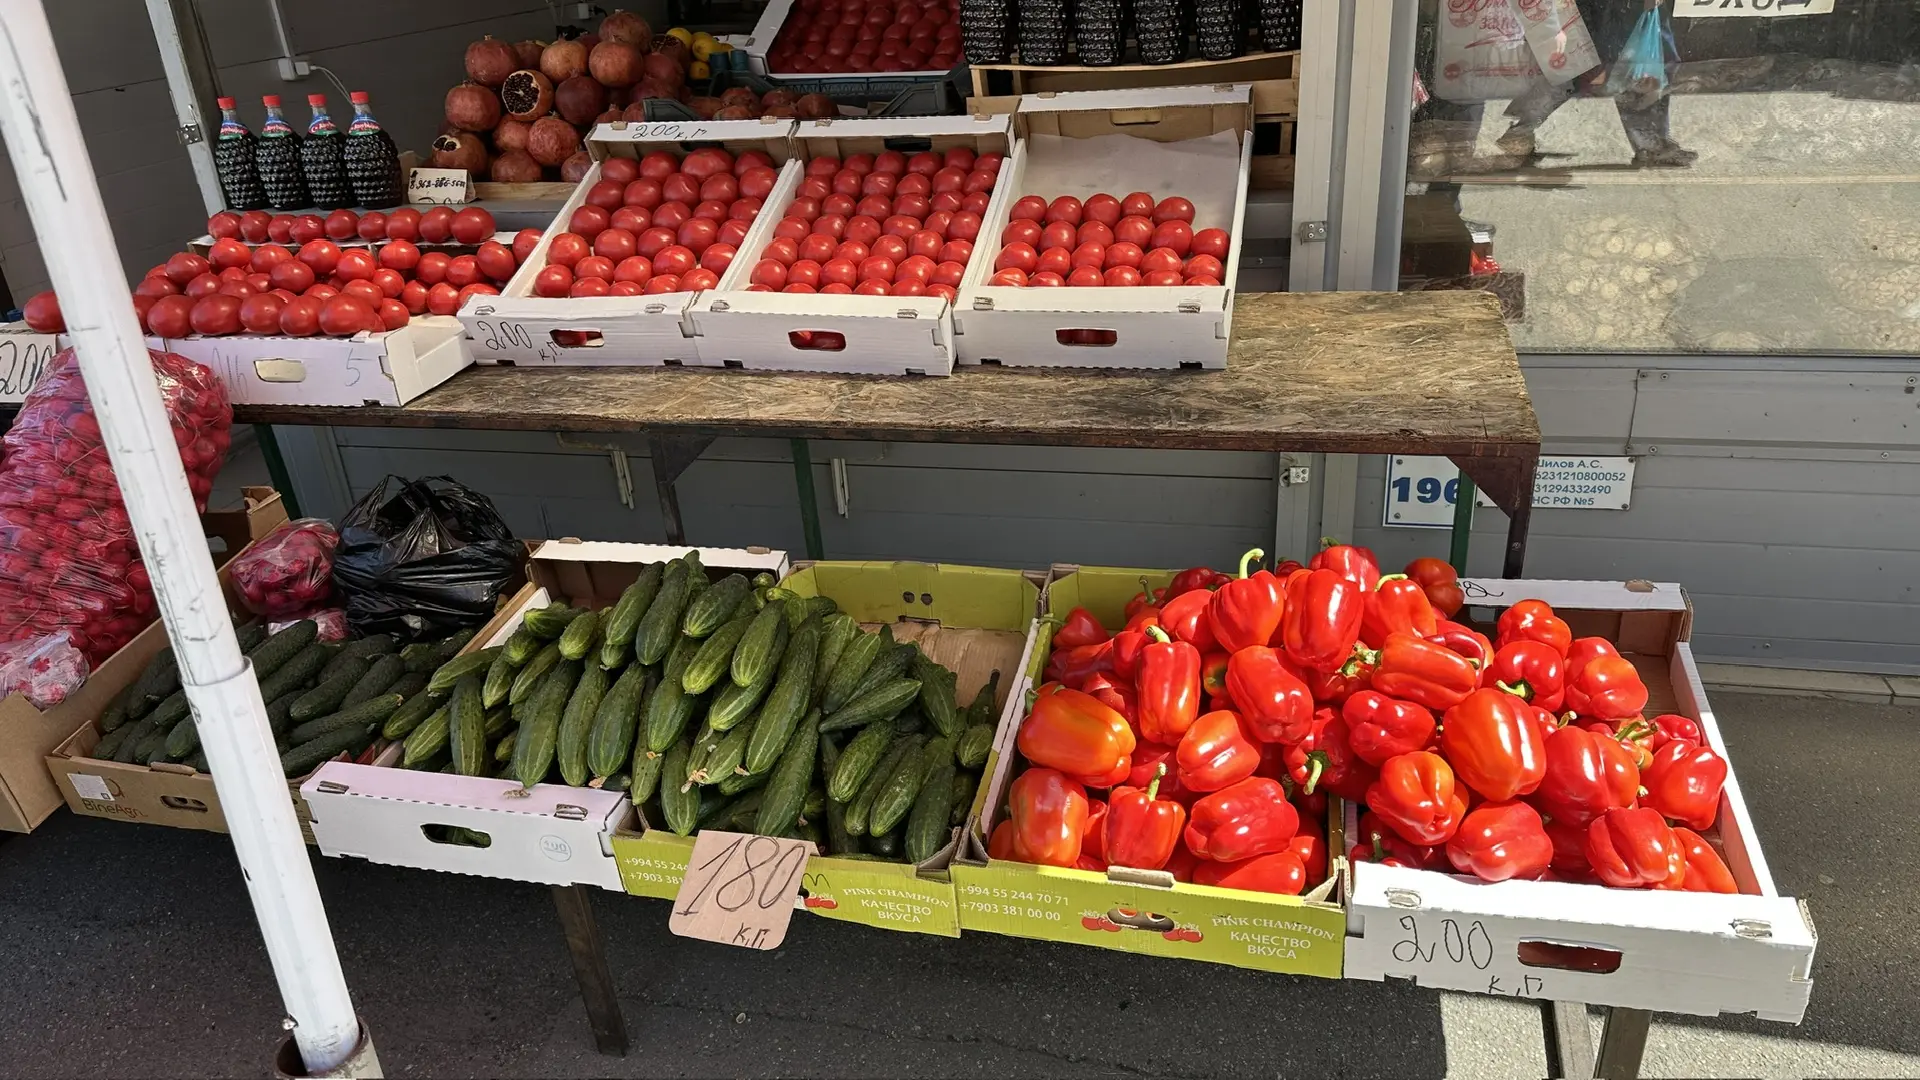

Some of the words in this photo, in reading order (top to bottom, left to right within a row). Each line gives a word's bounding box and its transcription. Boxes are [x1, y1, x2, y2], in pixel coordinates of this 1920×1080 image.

[632, 124, 680, 139] 200
[477, 321, 532, 350] 200
[345, 347, 373, 387] 5
[1577, 460, 1603, 469] А.С.
[1553, 496, 1571, 505] РФ
[1574, 497, 1595, 506] №5
[624, 857, 652, 868] +994
[655, 859, 668, 869] 55
[630, 872, 663, 883] +7903
[675, 836, 806, 916] 180
[843, 887, 876, 896] PINK
[881, 888, 951, 908] CHAMPION
[958, 885, 990, 897] +994
[993, 888, 1008, 898] 55
[1011, 890, 1034, 901] 244
[1036, 893, 1052, 904] 70
[1054, 896, 1069, 906] 71
[861, 899, 932, 916] КАЧЕСТВО
[960, 901, 998, 914] +7903
[1002, 904, 1023, 916] 381
[1027, 908, 1042, 918] 00
[1045, 911, 1061, 921] 00
[877, 911, 921, 923] ВКУСА
[1212, 916, 1250, 926] PINK
[1252, 918, 1335, 940] CHAMPION
[1230, 931, 1312, 949] КАЧЕСТВО
[1392, 915, 1493, 969] 200
[1247, 944, 1297, 959] ВКУСА
